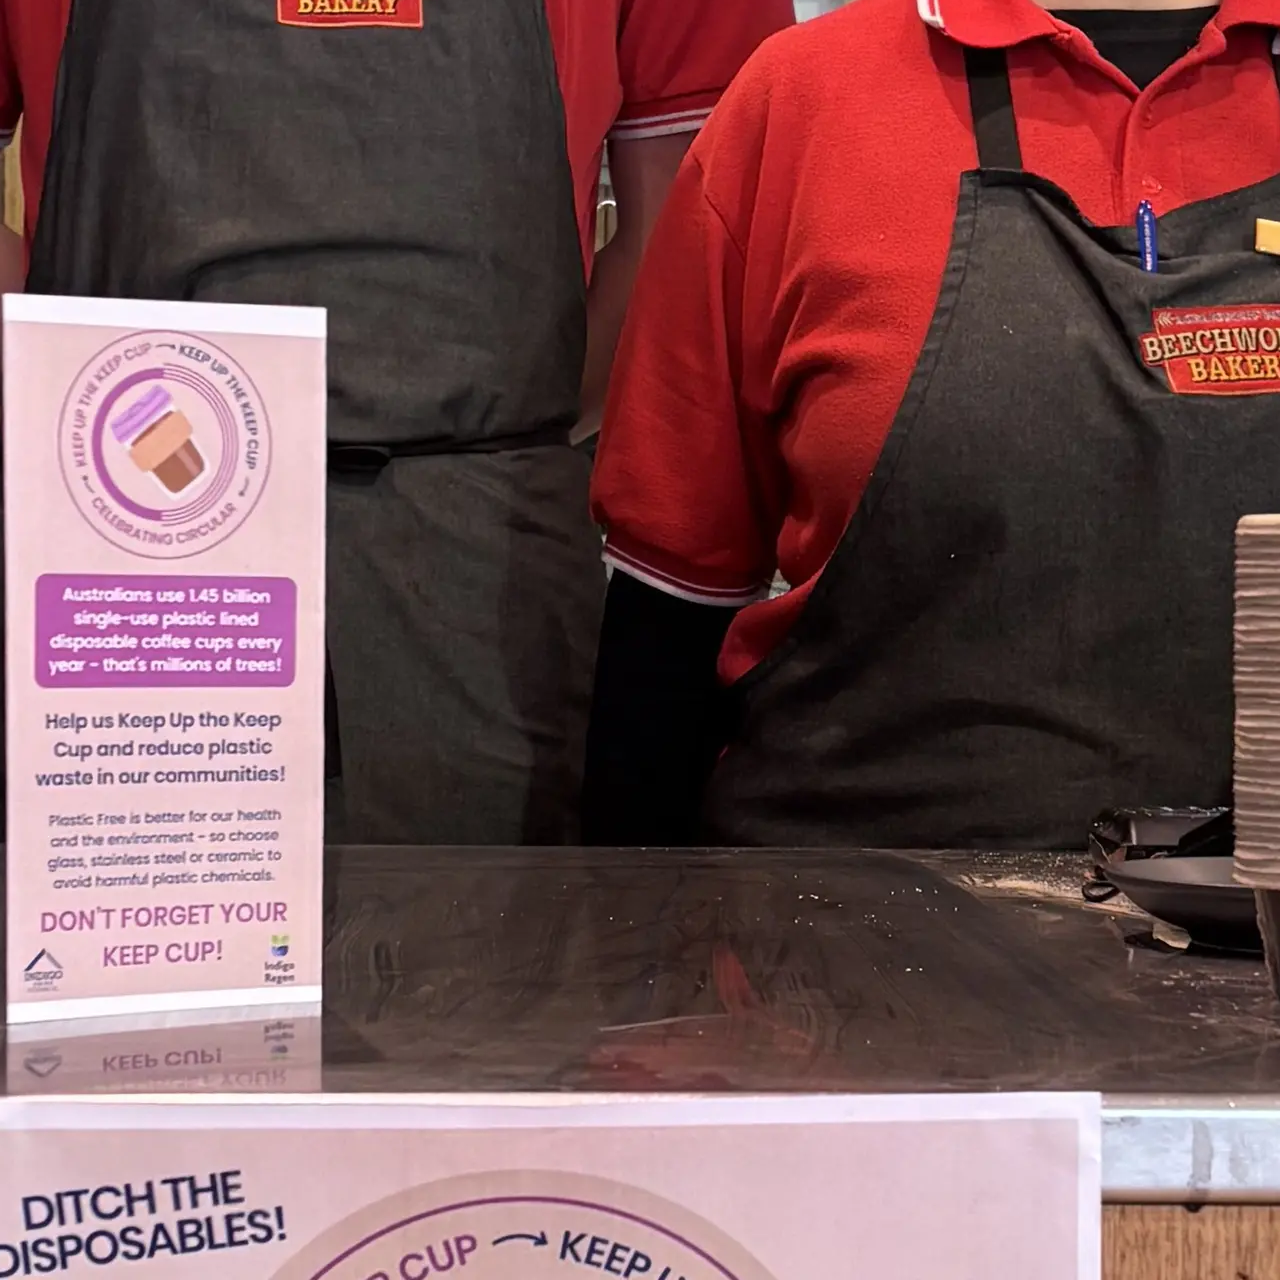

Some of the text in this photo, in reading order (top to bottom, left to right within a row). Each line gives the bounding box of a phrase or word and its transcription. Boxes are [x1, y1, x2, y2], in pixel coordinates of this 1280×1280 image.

[245, 438, 259, 470] CUP
[62, 587, 270, 603] Australians use 1.45 billion
[74, 610, 258, 629] single-use plastic lined
[50, 634, 282, 652] disposable coffee cups every
[49, 660, 84, 675] year
[103, 657, 146, 672] that's
[151, 658, 212, 672] millions
[216, 658, 232, 672] of
[236, 658, 281, 672] trees!
[46, 712, 281, 733] Help us Keep Up the Keep
[54, 738, 272, 761] Cup and reduce plastic
[36, 766, 285, 786] waste in our communities!
[49, 810, 281, 826] Plastic Free is better for our health
[51, 835, 78, 848] and
[82, 834, 103, 846] the
[108, 832, 194, 846] environment
[209, 832, 225, 842] so
[229, 830, 279, 842] choose
[48, 850, 281, 871] glass, stainless steel or ceramic to
[54, 869, 274, 889] avoid harmful plastic chemicals.
[41, 902, 287, 932] DON'T FORGET YOUR
[103, 940, 222, 967] KEEP CUP!
[21, 1169, 245, 1231] DITCH THE
[398, 1234, 478, 1280] CUP
[558, 1230, 653, 1280] KEEP
